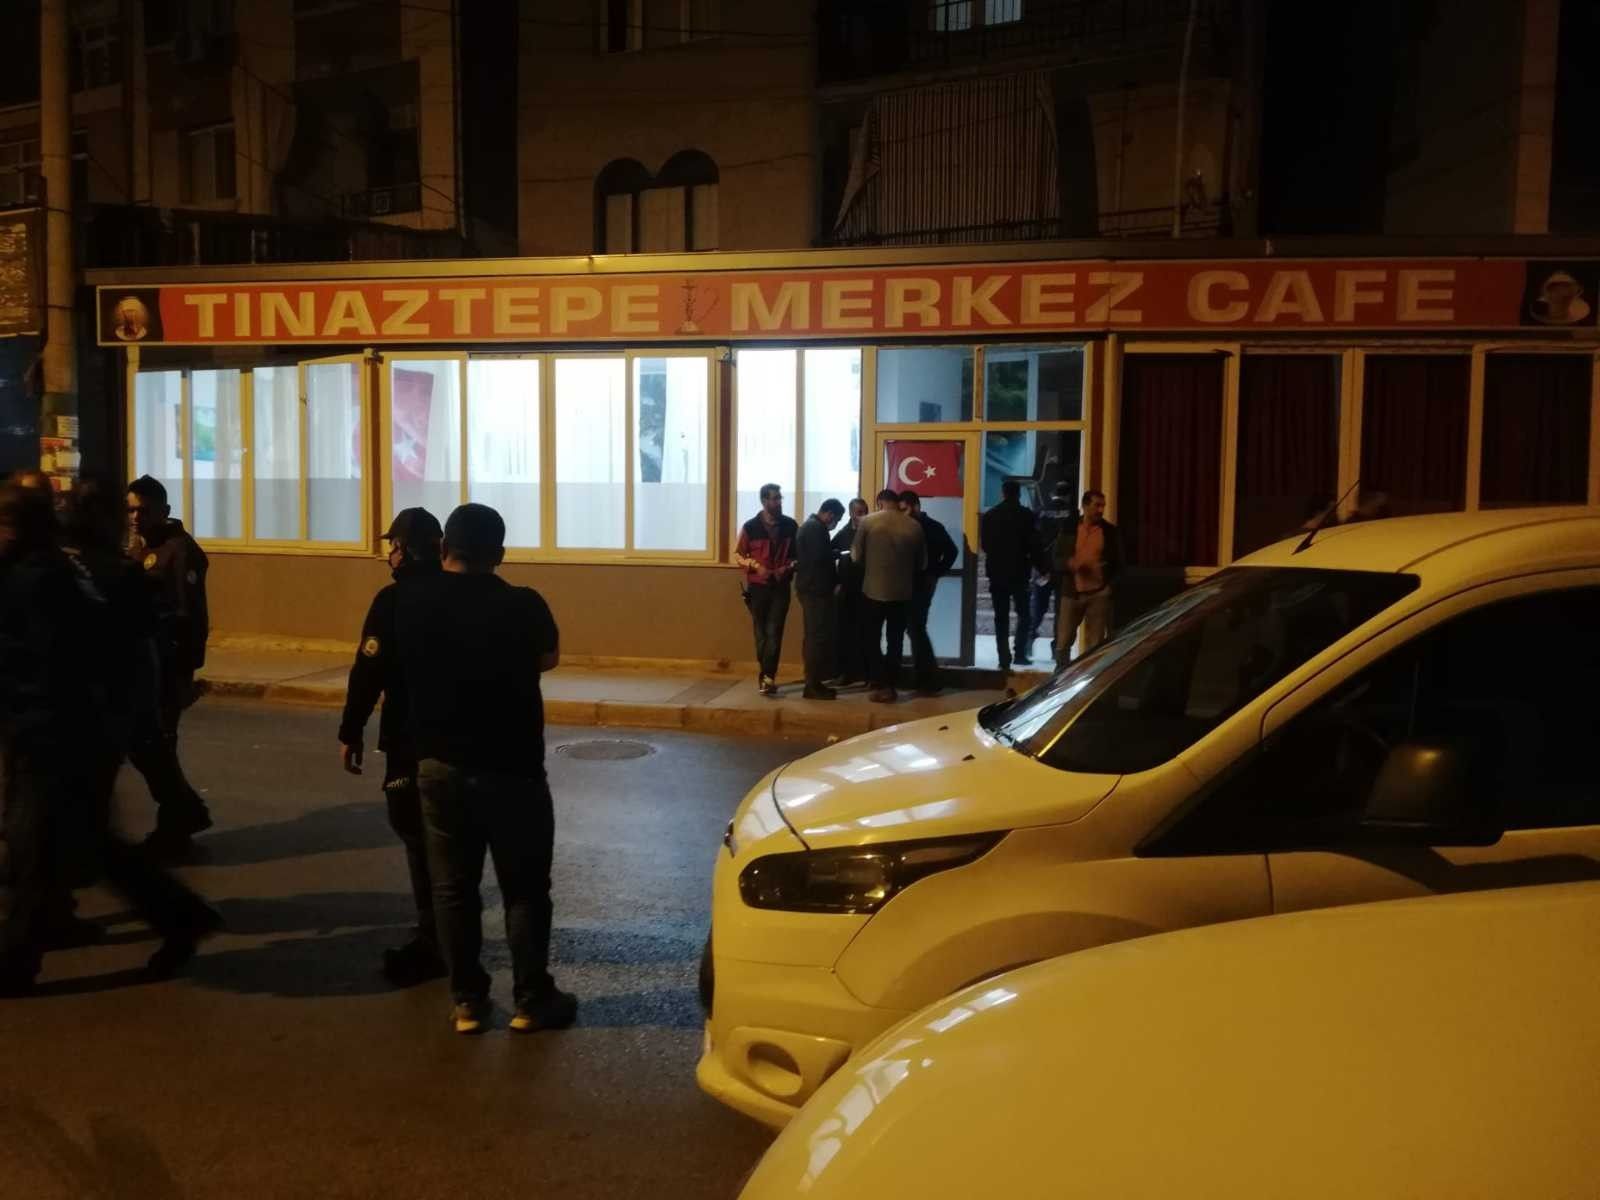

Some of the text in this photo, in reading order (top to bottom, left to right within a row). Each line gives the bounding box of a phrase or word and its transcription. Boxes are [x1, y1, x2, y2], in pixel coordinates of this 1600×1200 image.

[184, 268, 1457, 338] TINAZTEPE MERKEZ CAFE
